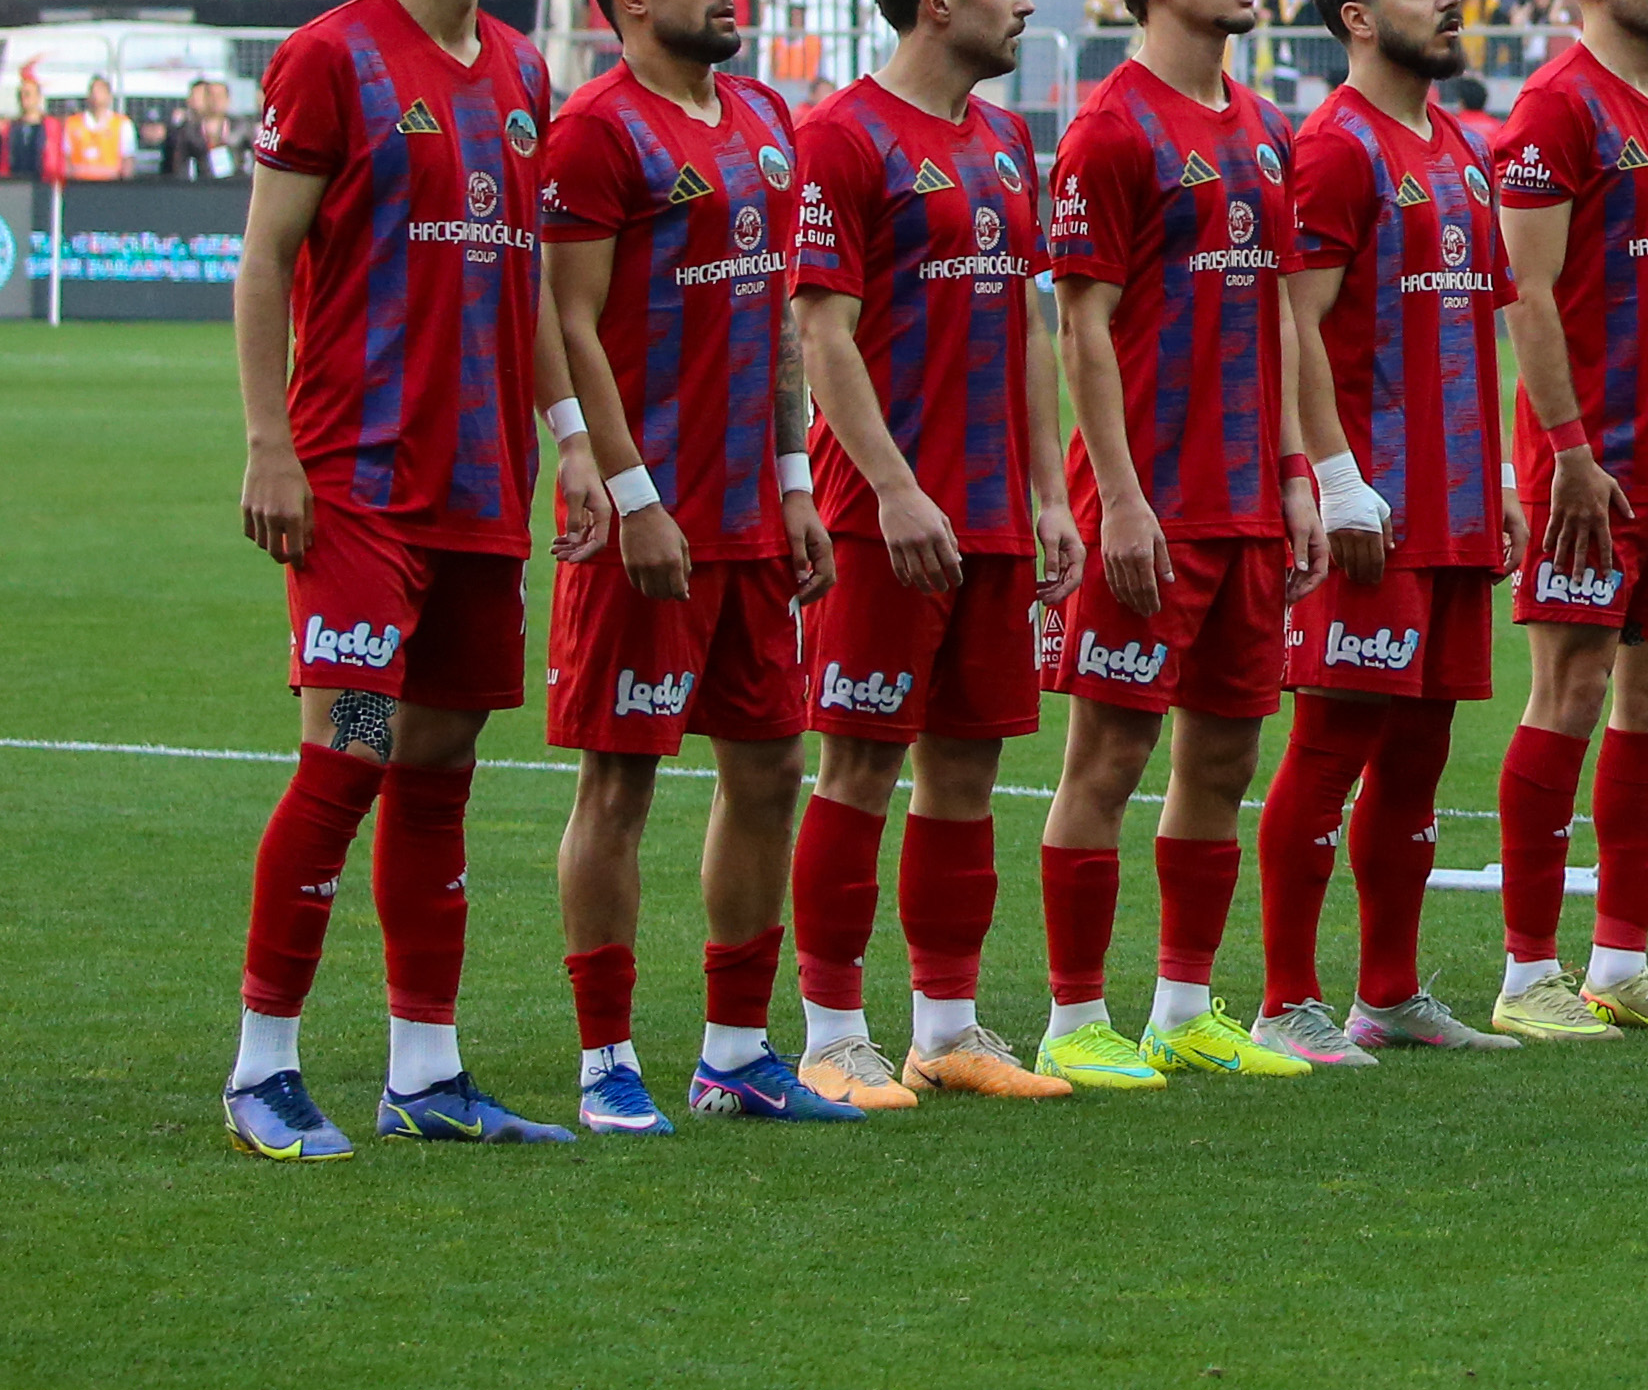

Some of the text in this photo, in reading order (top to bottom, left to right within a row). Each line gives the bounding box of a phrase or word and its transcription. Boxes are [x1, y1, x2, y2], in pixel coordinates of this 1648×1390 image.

[466, 249, 498, 263] GROUP
[1226, 274, 1255, 286] GROUP
[735, 281, 766, 296] GROUP
[974, 282, 1003, 294] GROUP
[1442, 296, 1469, 309] GROUP
[1535, 559, 1624, 608] Lody
[303, 614, 400, 668] Lody
[1077, 628, 1168, 684] Lody
[1325, 620, 1420, 671] Lody
[615, 668, 695, 717] Lody
[820, 660, 914, 714] Lody
